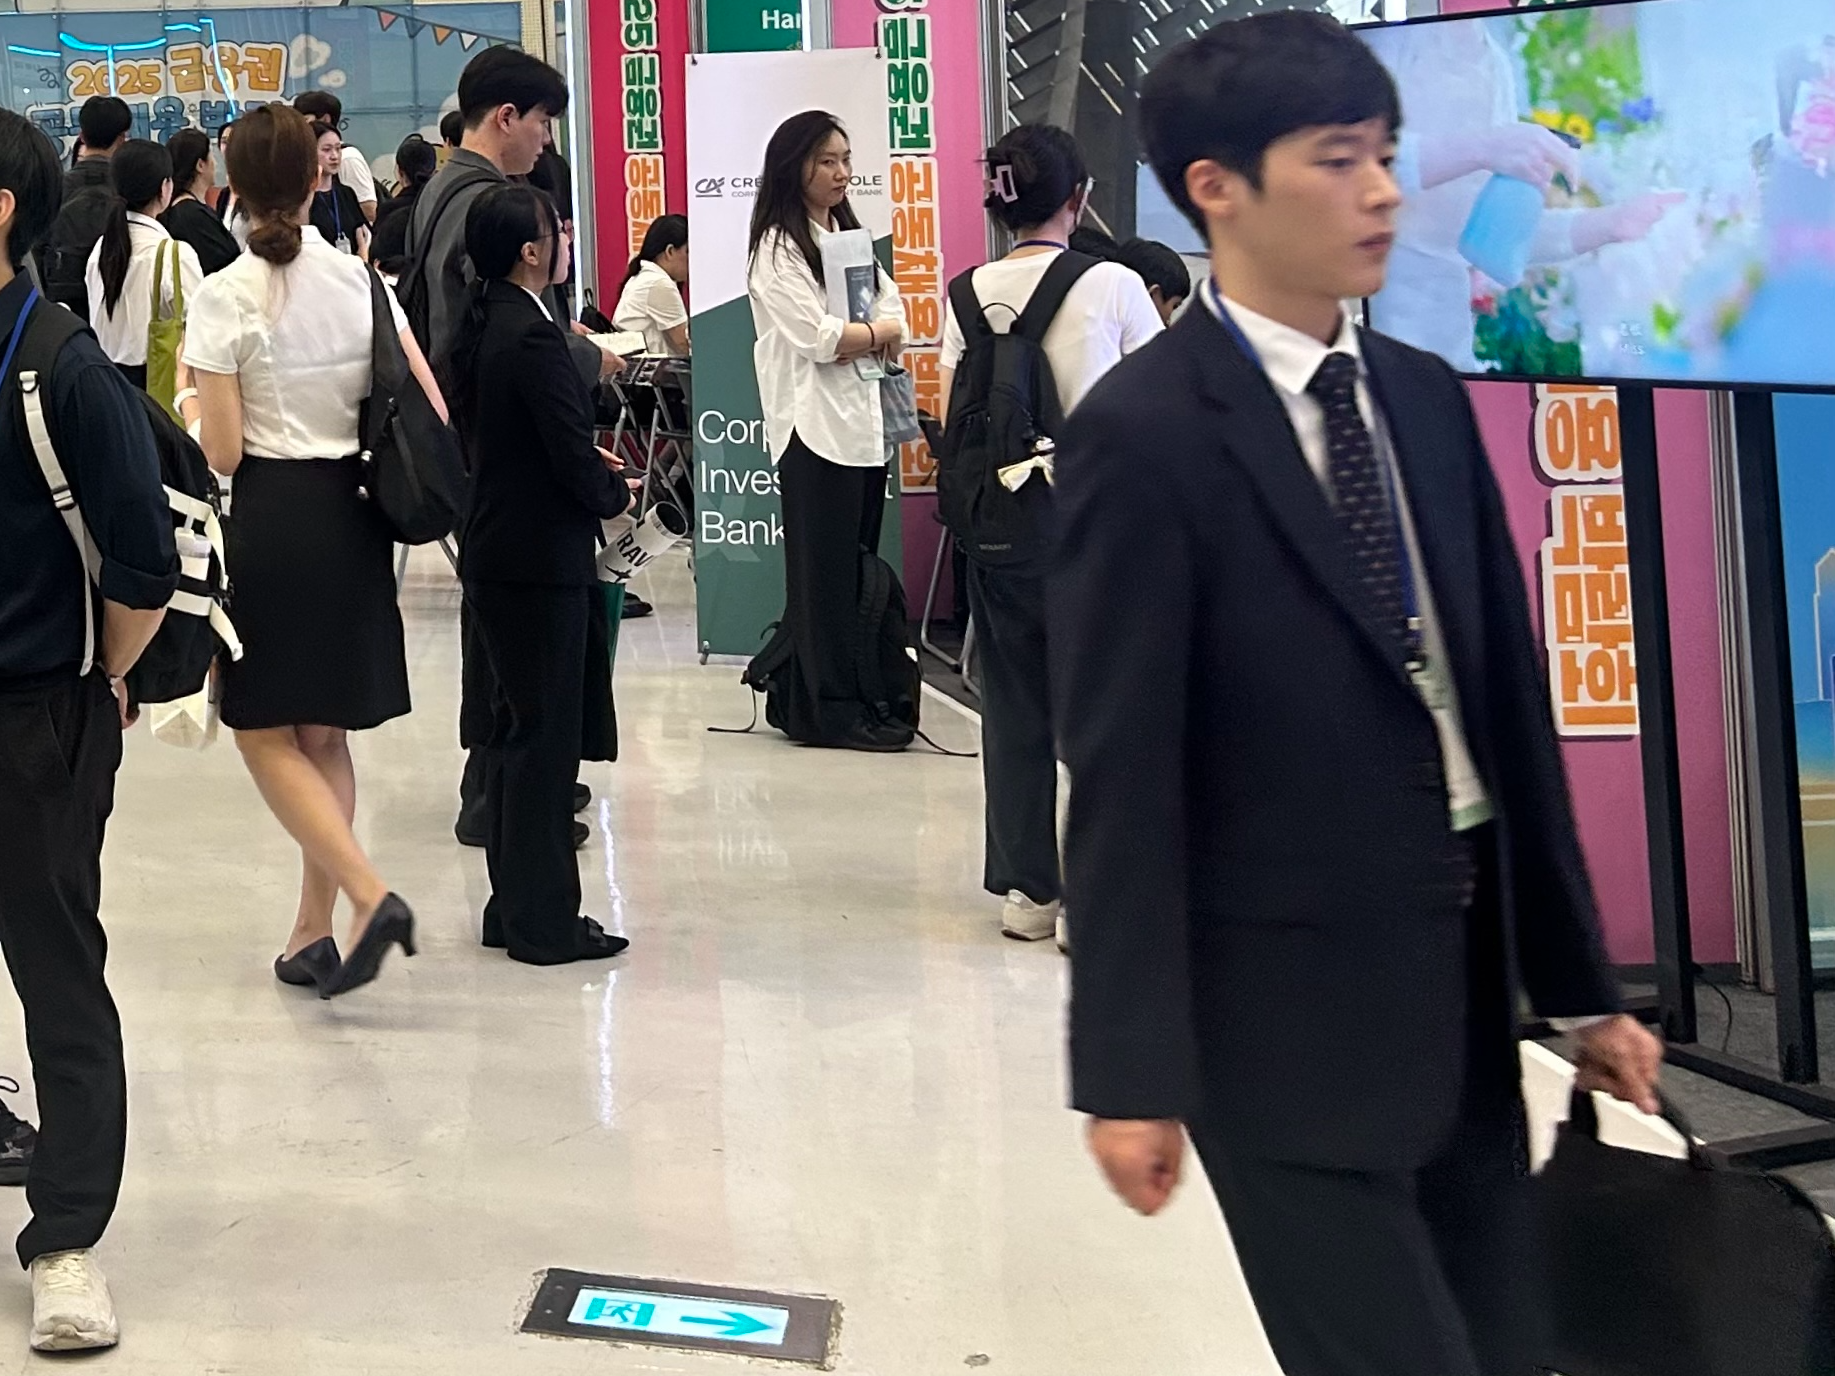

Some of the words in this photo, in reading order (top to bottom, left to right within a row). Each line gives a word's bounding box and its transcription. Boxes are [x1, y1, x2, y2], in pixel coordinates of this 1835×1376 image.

[71, 63, 162, 96] 2025
[170, 45, 283, 94] 금융권
[625, 55, 660, 150] 금융권
[883, 17, 932, 150] 금융권
[628, 157, 661, 264] 공동
[856, 188, 883, 196] BANK
